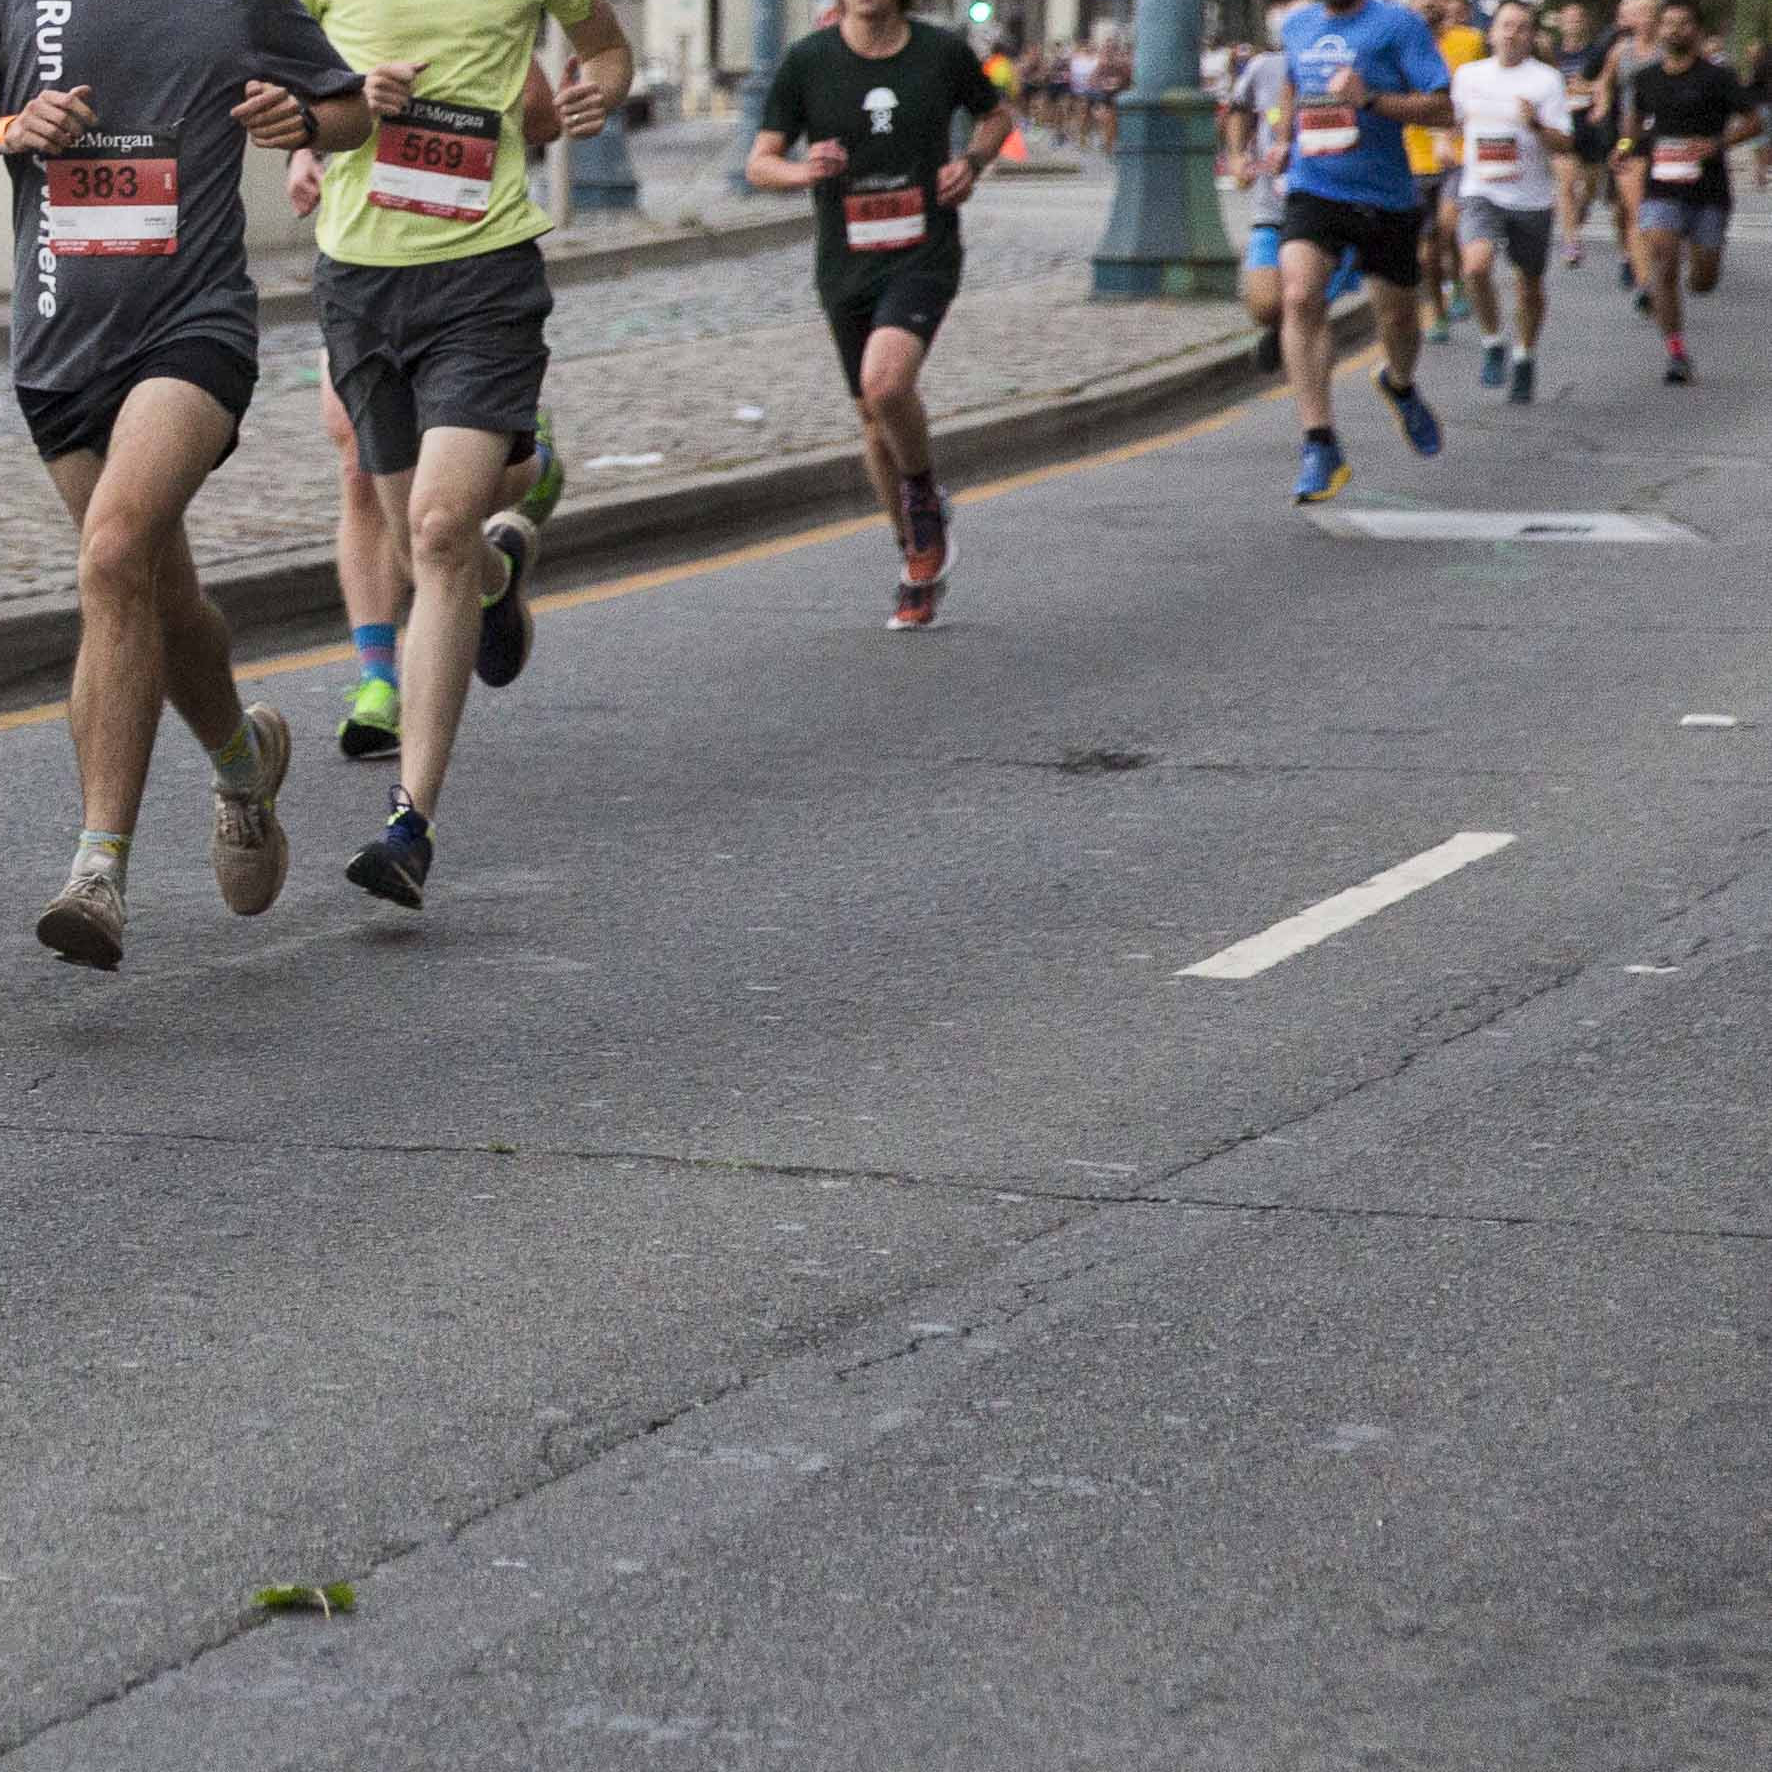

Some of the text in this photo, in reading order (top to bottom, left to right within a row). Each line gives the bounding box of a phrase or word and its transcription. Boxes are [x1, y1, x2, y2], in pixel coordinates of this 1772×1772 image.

[36, 0, 73, 81] Run
[400, 132, 463, 168] 569
[71, 166, 137, 198] 383
